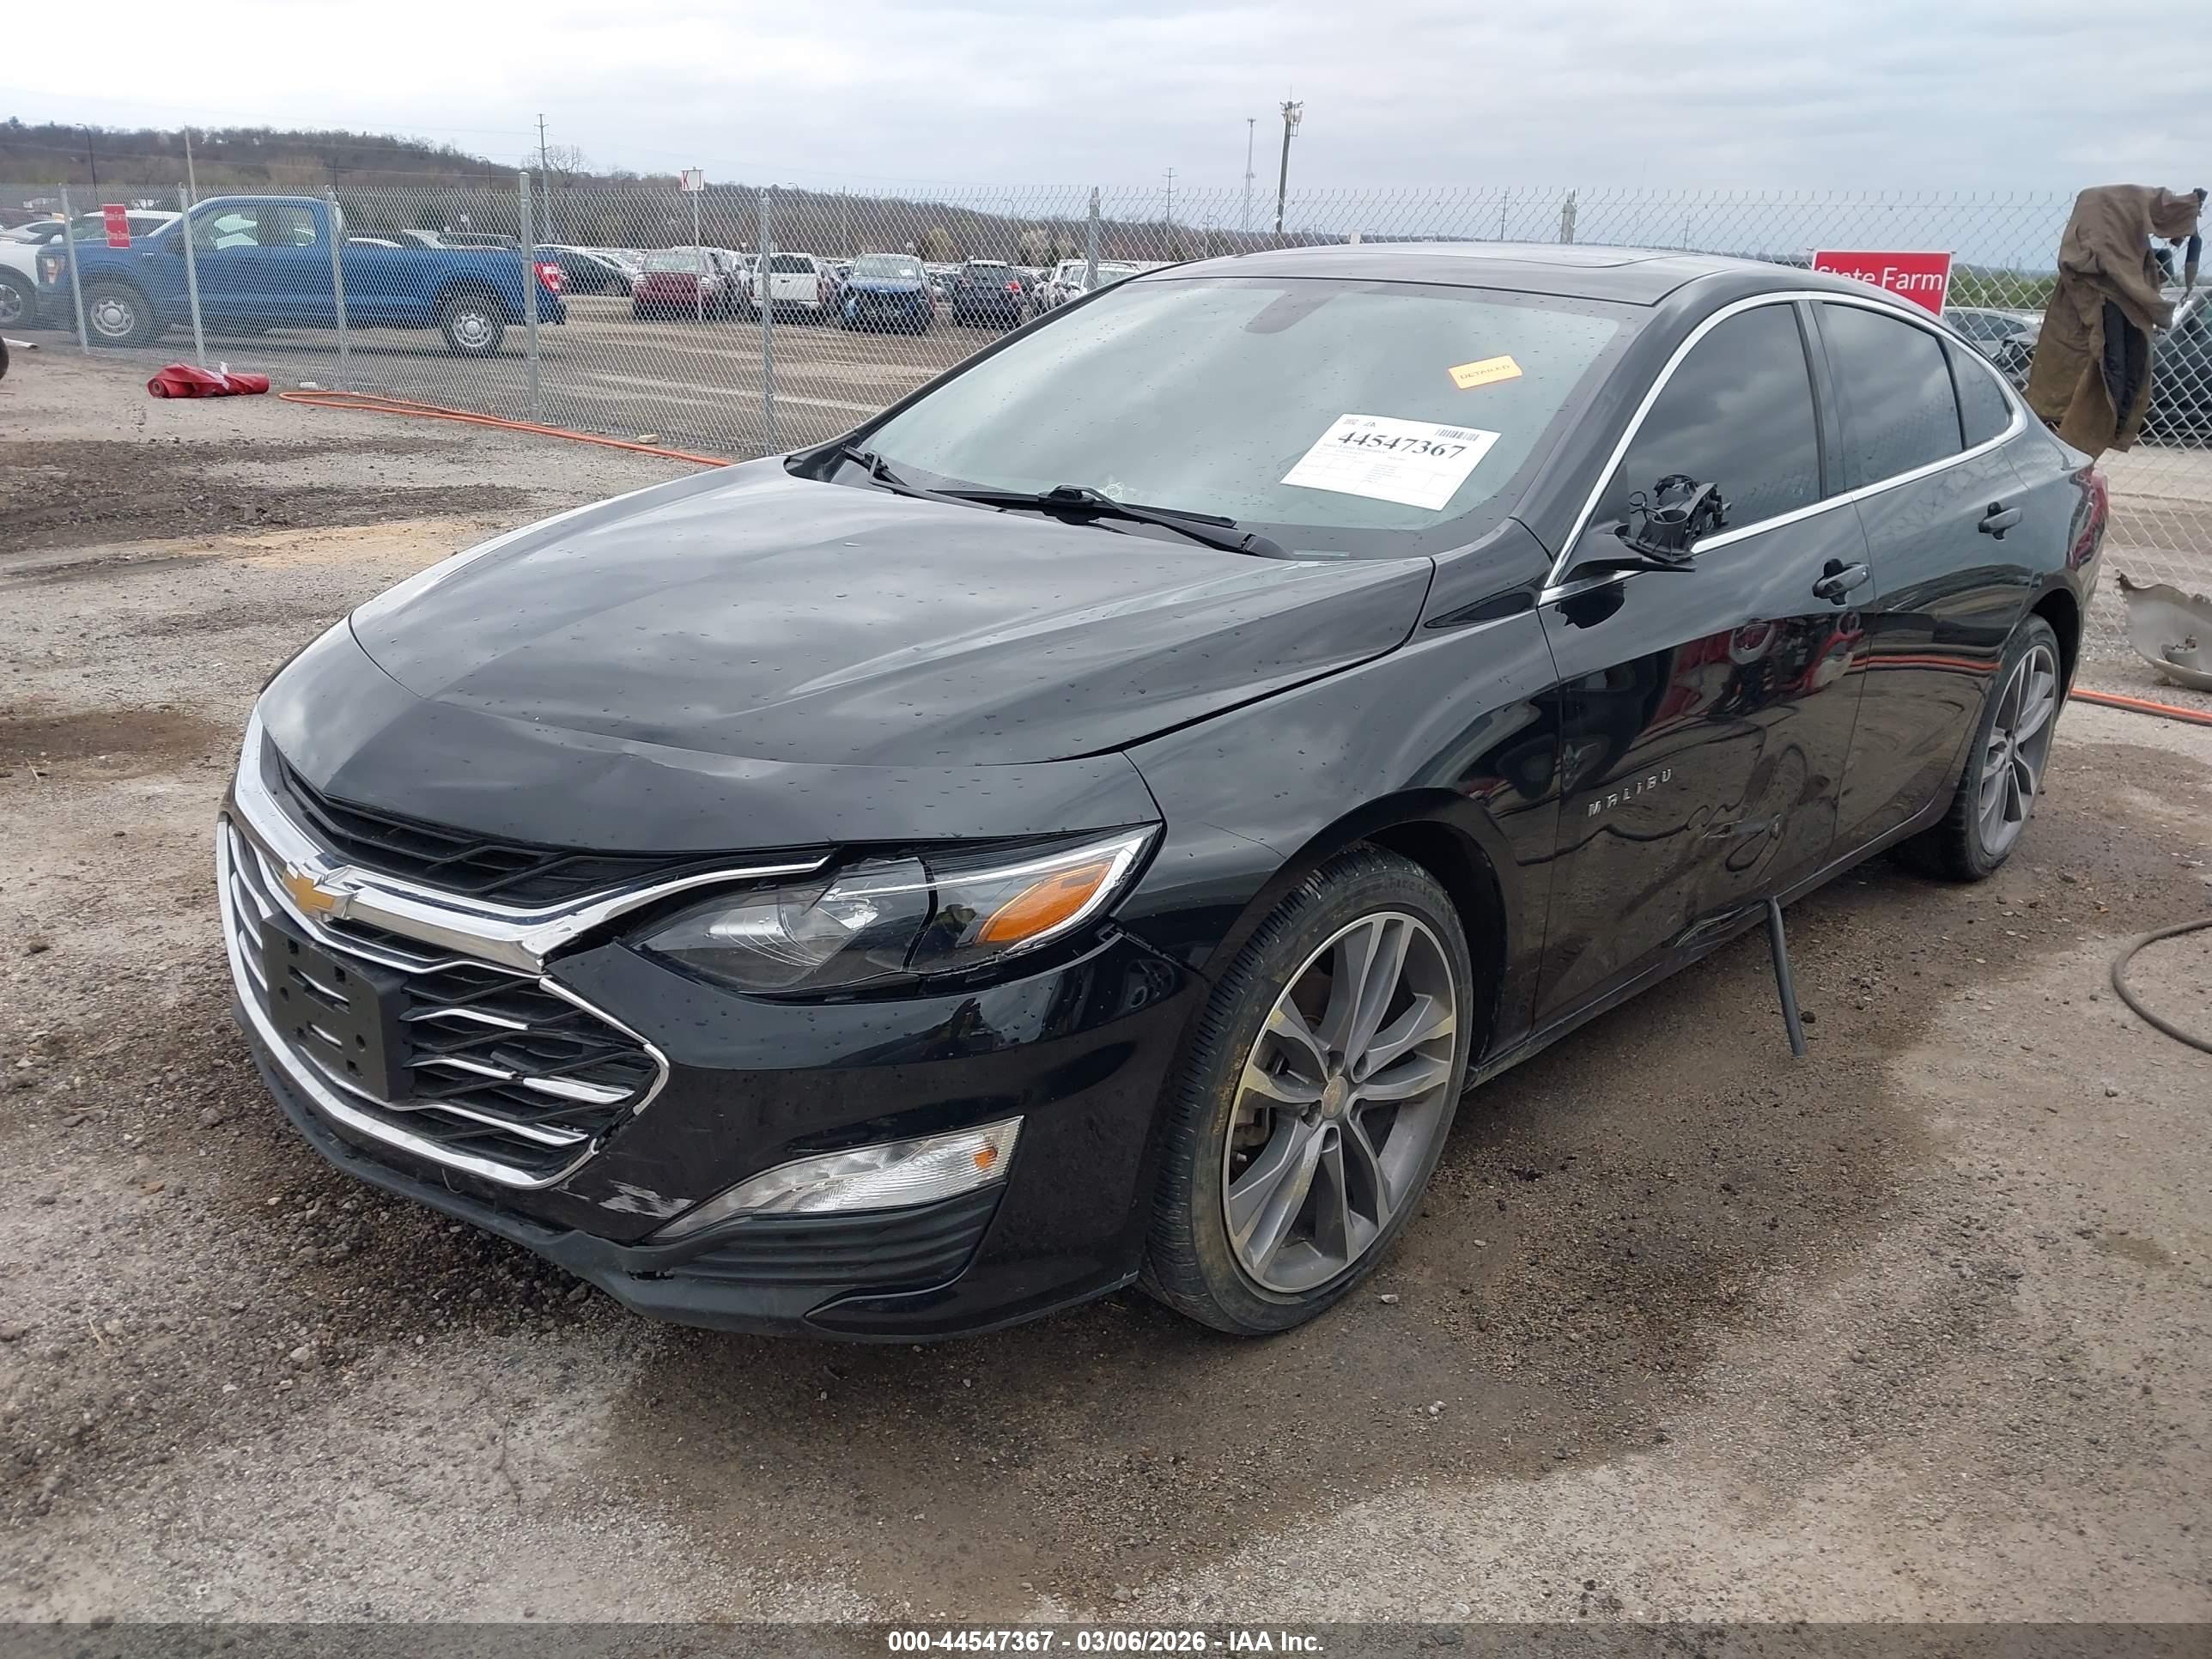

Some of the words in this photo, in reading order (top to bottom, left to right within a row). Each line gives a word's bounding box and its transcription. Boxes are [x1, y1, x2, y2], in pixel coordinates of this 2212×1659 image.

[681, 171, 690, 190] K
[1881, 267, 1943, 290] Farm
[1338, 431, 1468, 459] 44547367
[1587, 769, 1673, 817] MALIBU
